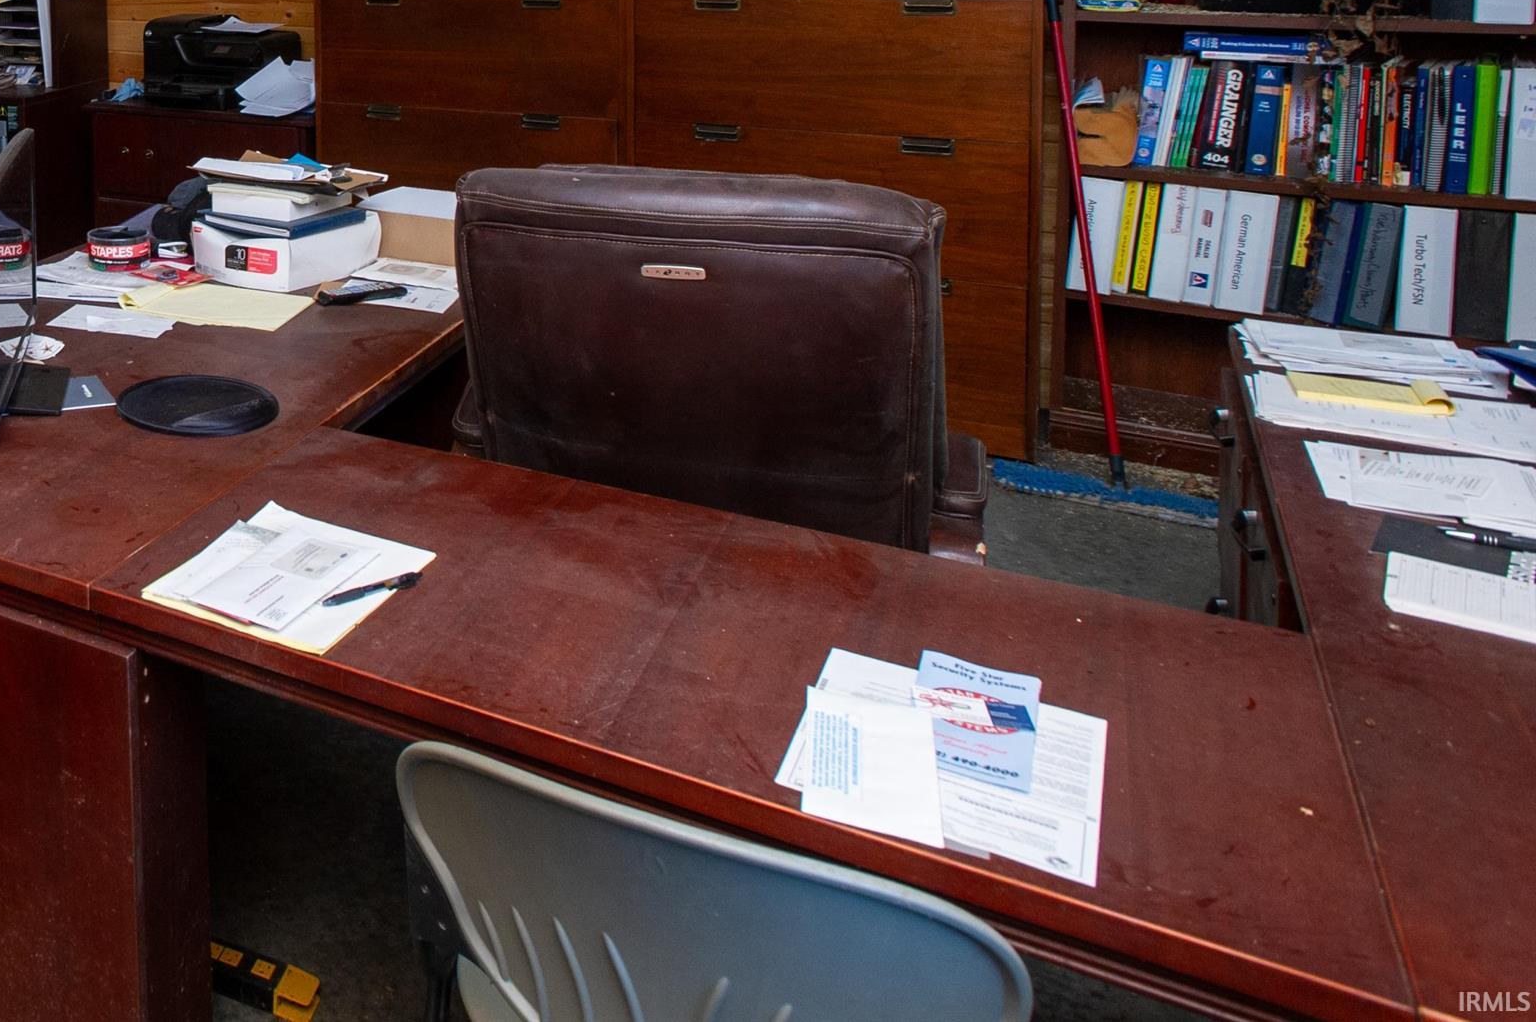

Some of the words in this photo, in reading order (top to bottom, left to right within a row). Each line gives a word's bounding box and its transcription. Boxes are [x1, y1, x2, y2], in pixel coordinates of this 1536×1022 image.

[1216, 69, 1243, 147] GRAINGER
[1452, 103, 1466, 149] LEER
[1203, 152, 1230, 163] 404
[1239, 214, 1252, 248] German
[90, 244, 134, 257] STAPLES
[236, 248, 246, 261] 10
[1203, 240, 1212, 259] DEALER
[1415, 234, 1428, 261] Turbo
[1230, 249, 1246, 290] American
[1412, 262, 1428, 306] Tech/FSN
[931, 662, 975, 680] Security
[980, 677, 1027, 691] Systems
[955, 663, 977, 675] Five
[982, 671, 1004, 681] Star
[951, 753, 1020, 777] 490-4000
